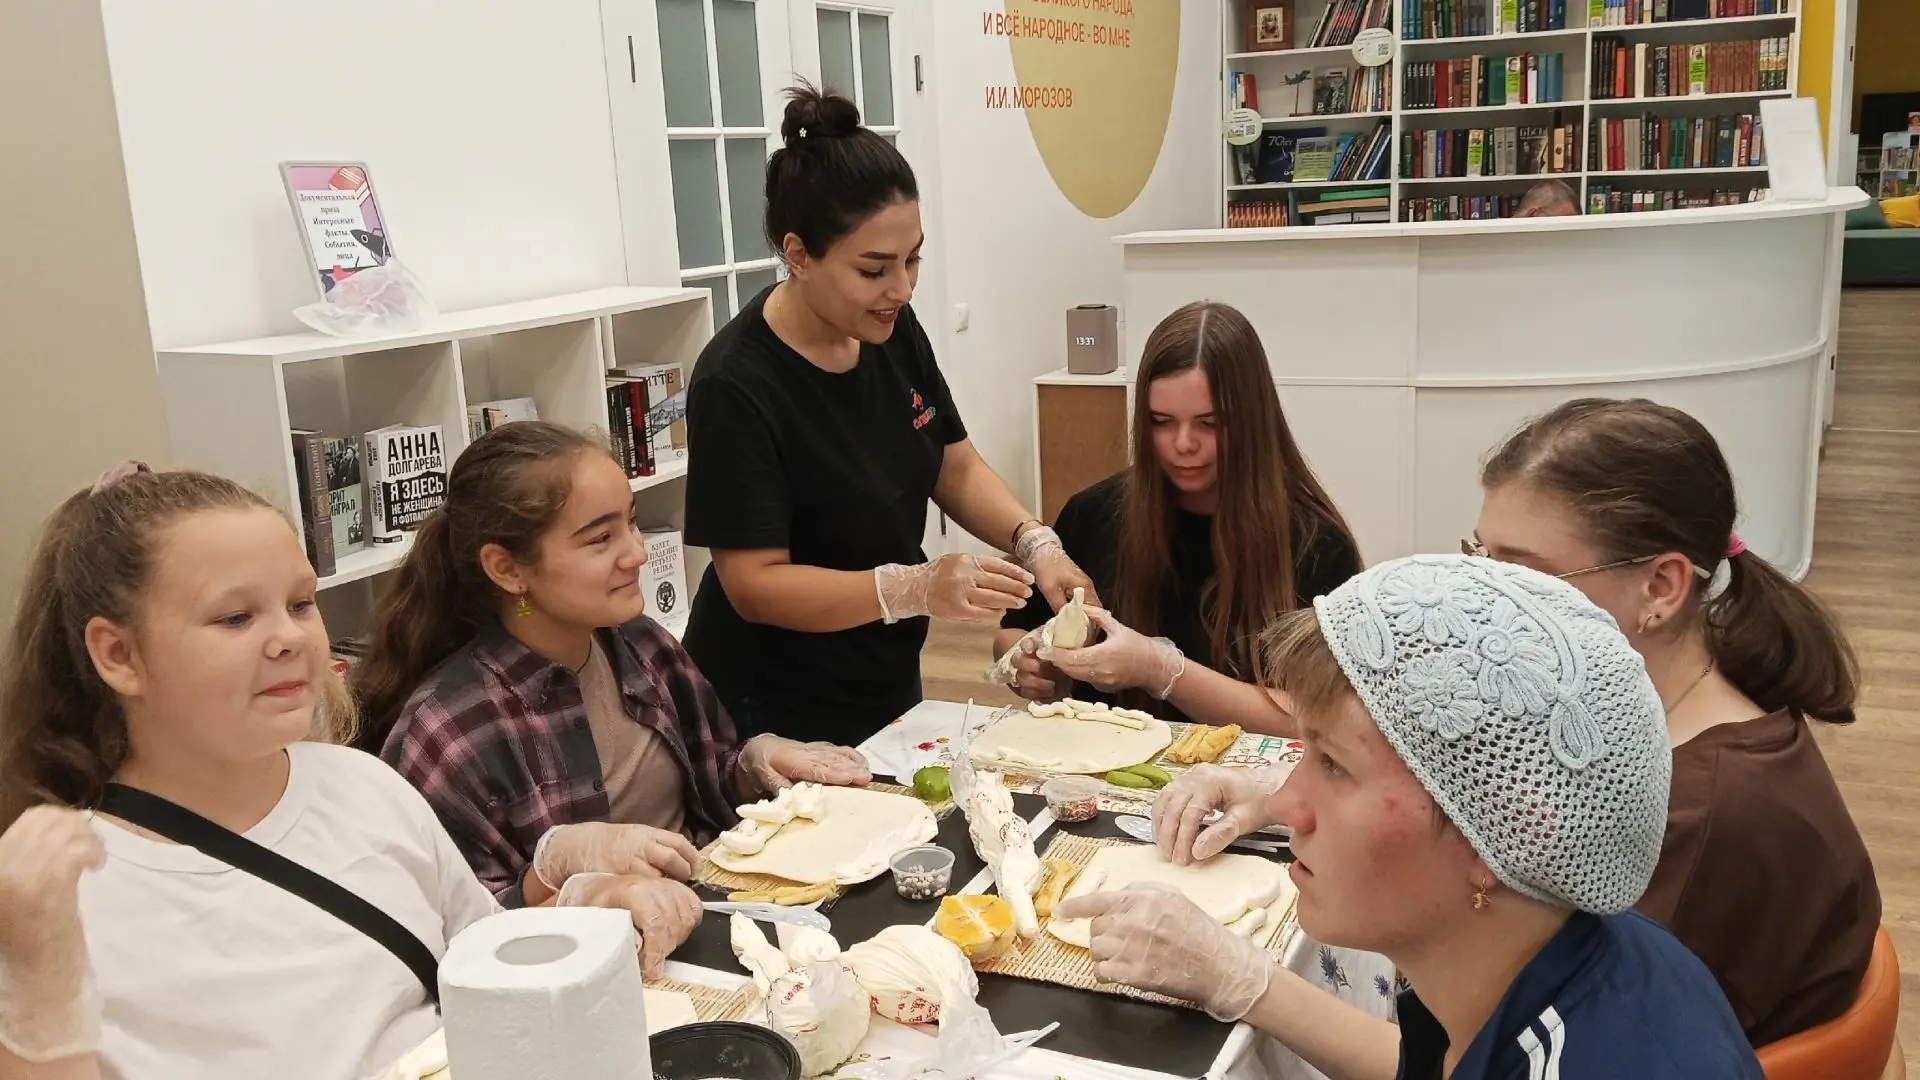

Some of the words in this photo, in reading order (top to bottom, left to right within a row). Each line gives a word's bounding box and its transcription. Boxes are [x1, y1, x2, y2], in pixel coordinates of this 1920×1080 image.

[983, 12, 992, 34] И
[996, 10, 1020, 37] ВСЁ
[1022, 16, 1085, 44] НАРОДНОЕ
[1093, 24, 1107, 44] ВО
[1108, 27, 1130, 48] МНЕ
[985, 86, 1011, 108] И.И.
[1013, 86, 1073, 109] МОРОЗОВ
[388, 431, 441, 463] АННА
[388, 455, 442, 478] ДОЛГАРЕВА
[390, 483, 400, 502] Я
[402, 475, 445, 500] ЗДЕСЬ
[391, 502, 402, 516] НЕ
[403, 495, 443, 513] ЖЕНЩИНА
[392, 516, 398, 527] Я
